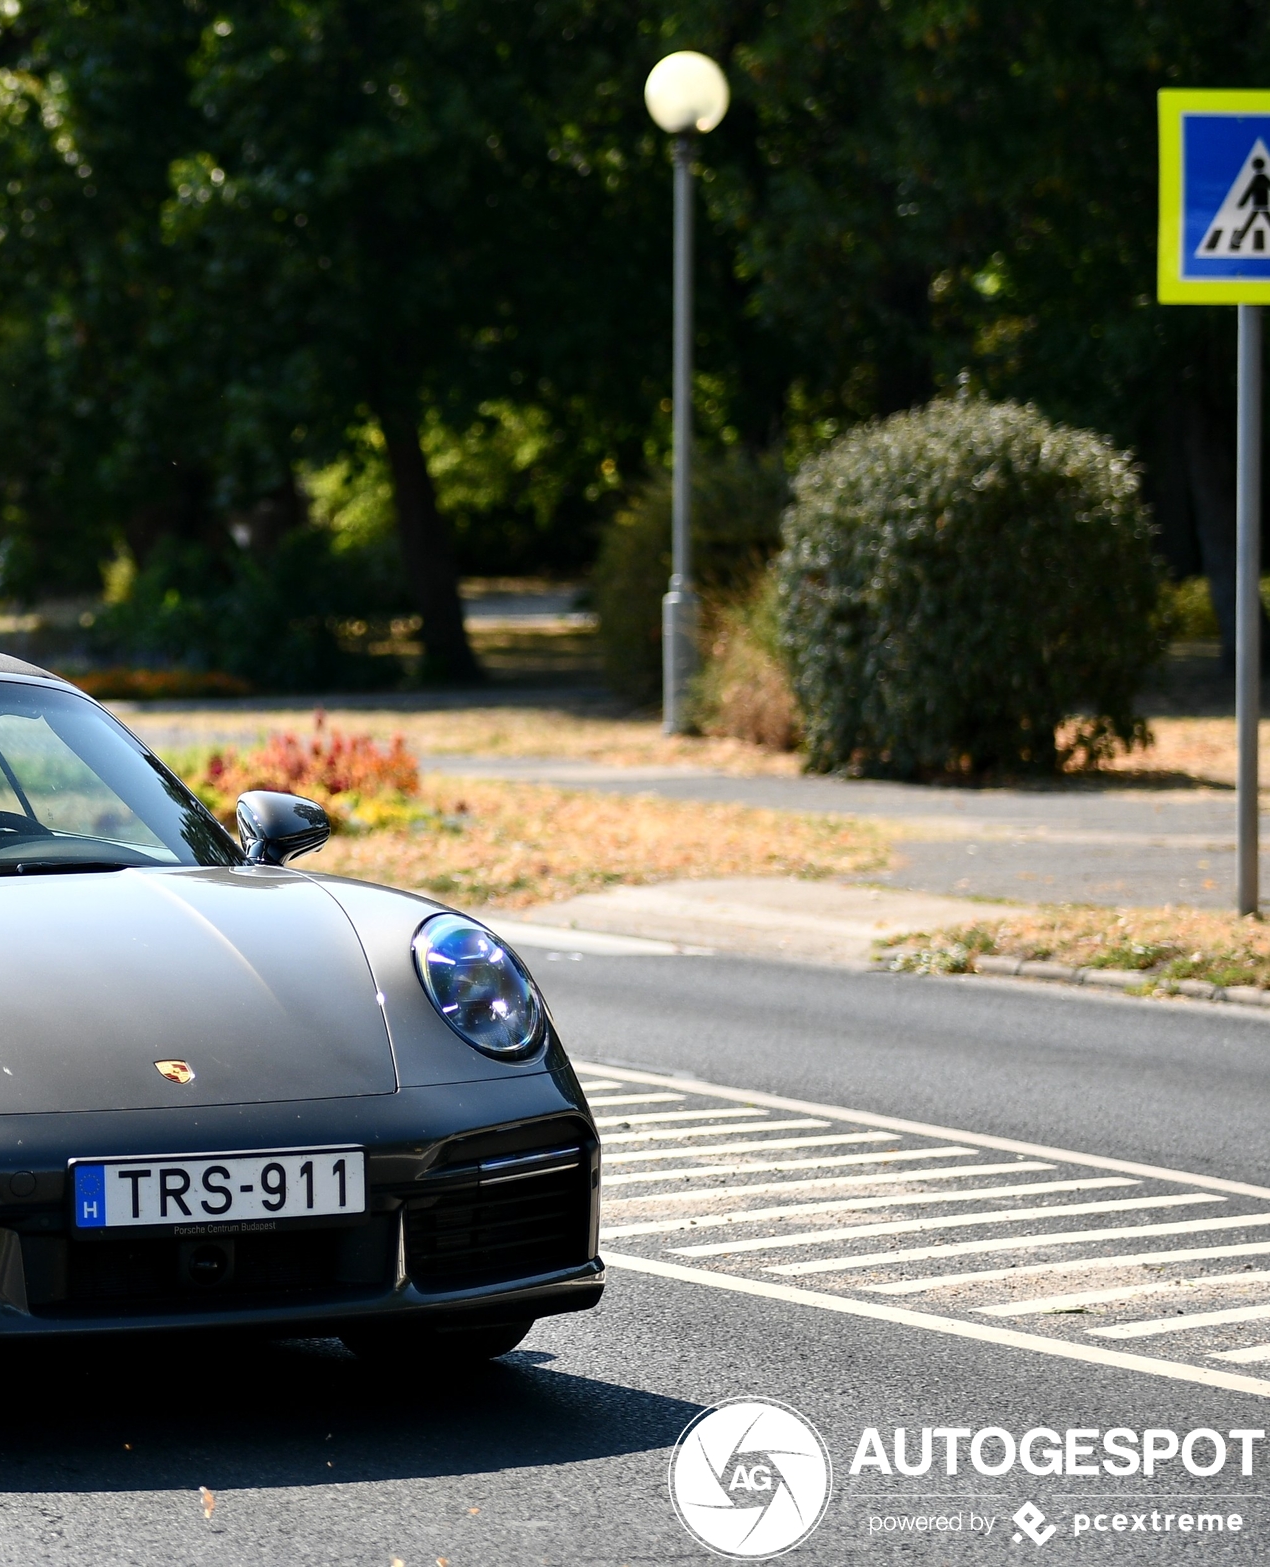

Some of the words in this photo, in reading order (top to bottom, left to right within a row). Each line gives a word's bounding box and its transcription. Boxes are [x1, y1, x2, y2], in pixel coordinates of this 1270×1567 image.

[118, 1158, 346, 1219] TRS-911
[83, 1201, 98, 1219] H
[174, 1225, 206, 1235] Porsche
[207, 1223, 240, 1233] Centrum
[241, 1221, 276, 1231] Budapest
